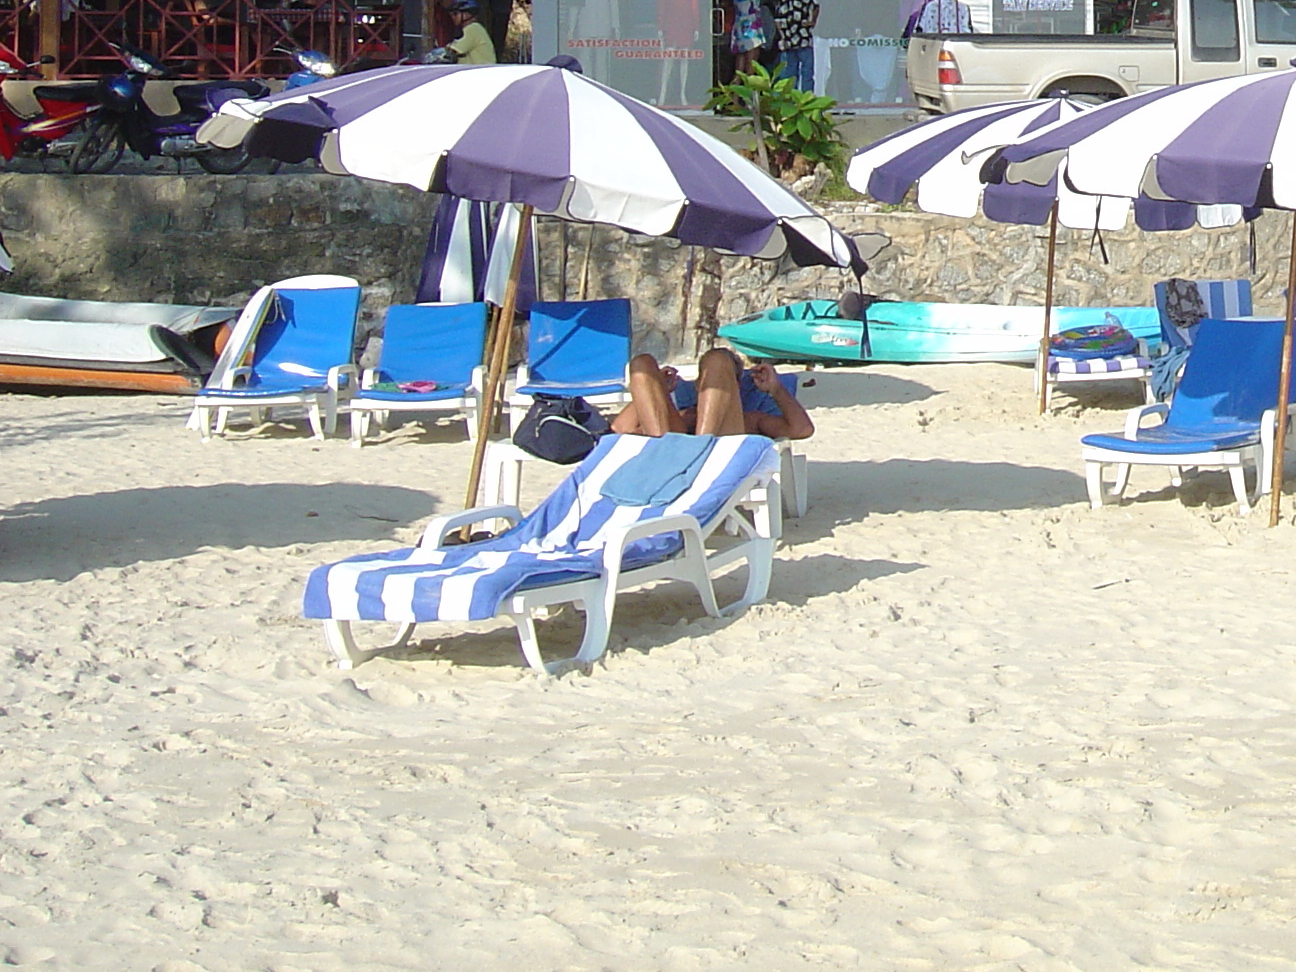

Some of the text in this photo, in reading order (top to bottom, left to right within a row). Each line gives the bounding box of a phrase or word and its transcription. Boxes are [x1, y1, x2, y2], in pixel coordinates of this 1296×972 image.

[567, 39, 662, 47] SATISFACTION
[829, 38, 910, 47] NO COMISSIO
[614, 50, 704, 58] GUARANTEED
